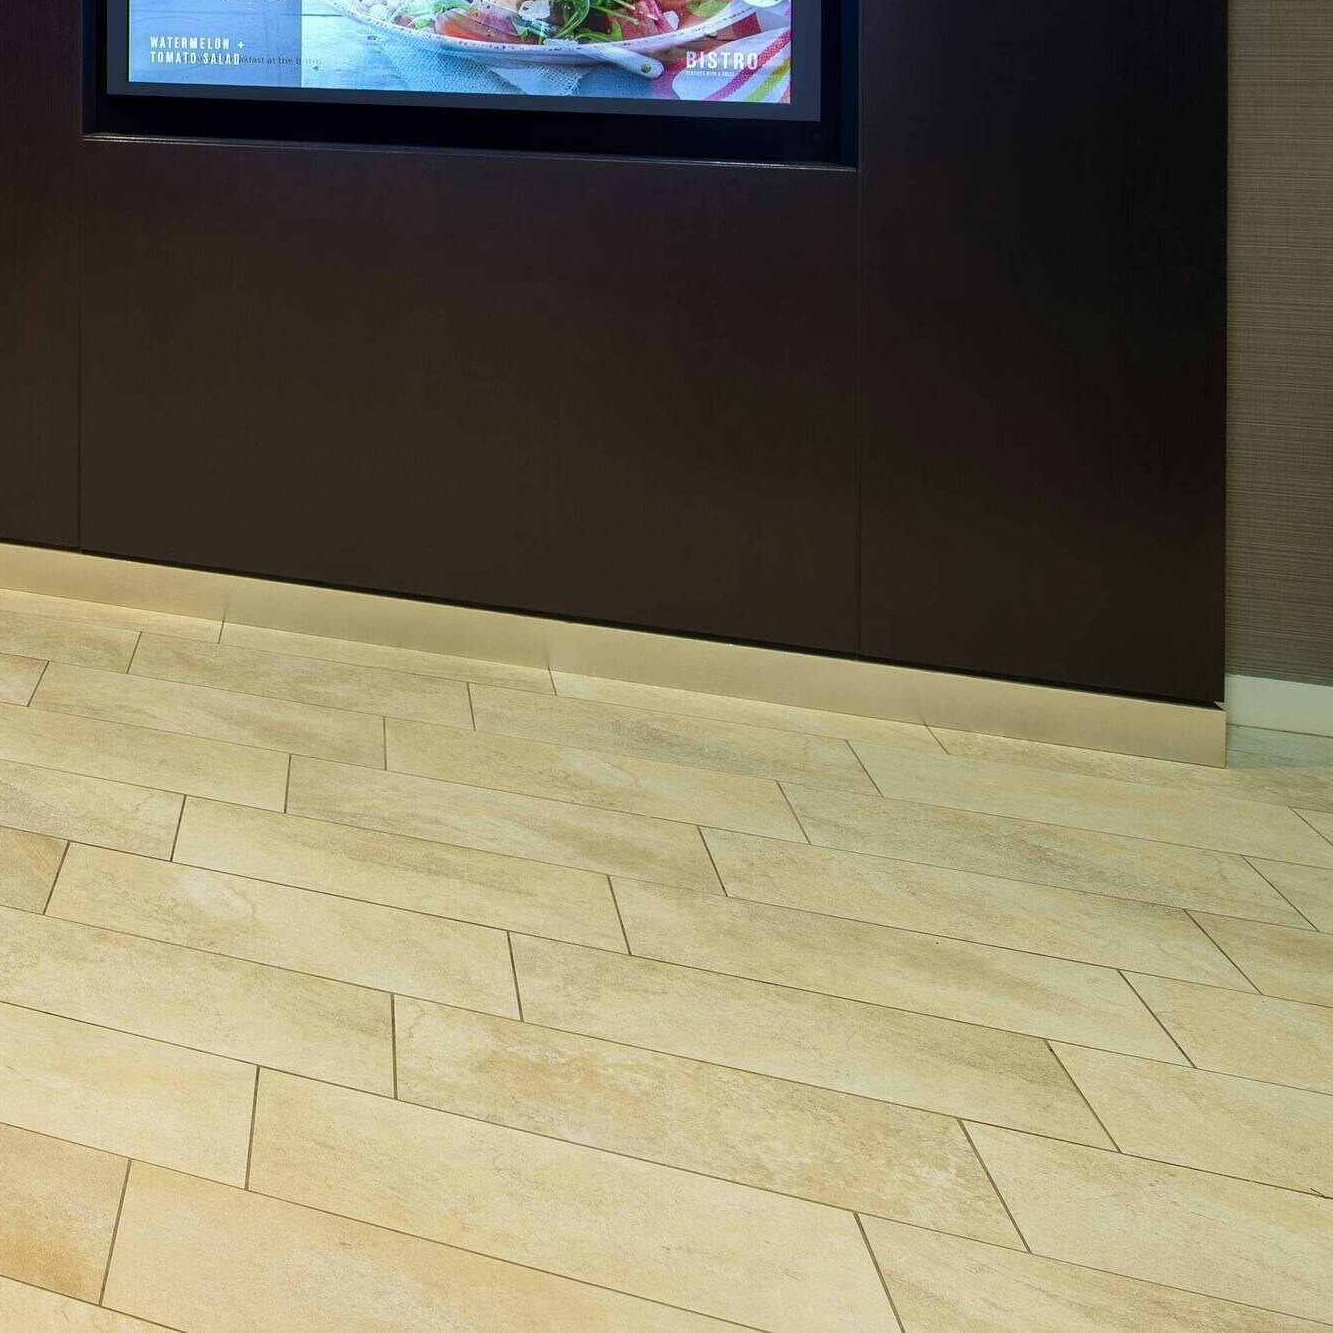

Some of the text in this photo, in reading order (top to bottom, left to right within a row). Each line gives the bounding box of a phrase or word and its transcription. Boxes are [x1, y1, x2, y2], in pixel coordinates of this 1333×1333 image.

[150, 36, 245, 51] WATERMELON +
[150, 51, 197, 64] TOMATO
[203, 53, 241, 65] SALAD
[686, 51, 758, 70] BISTRO
